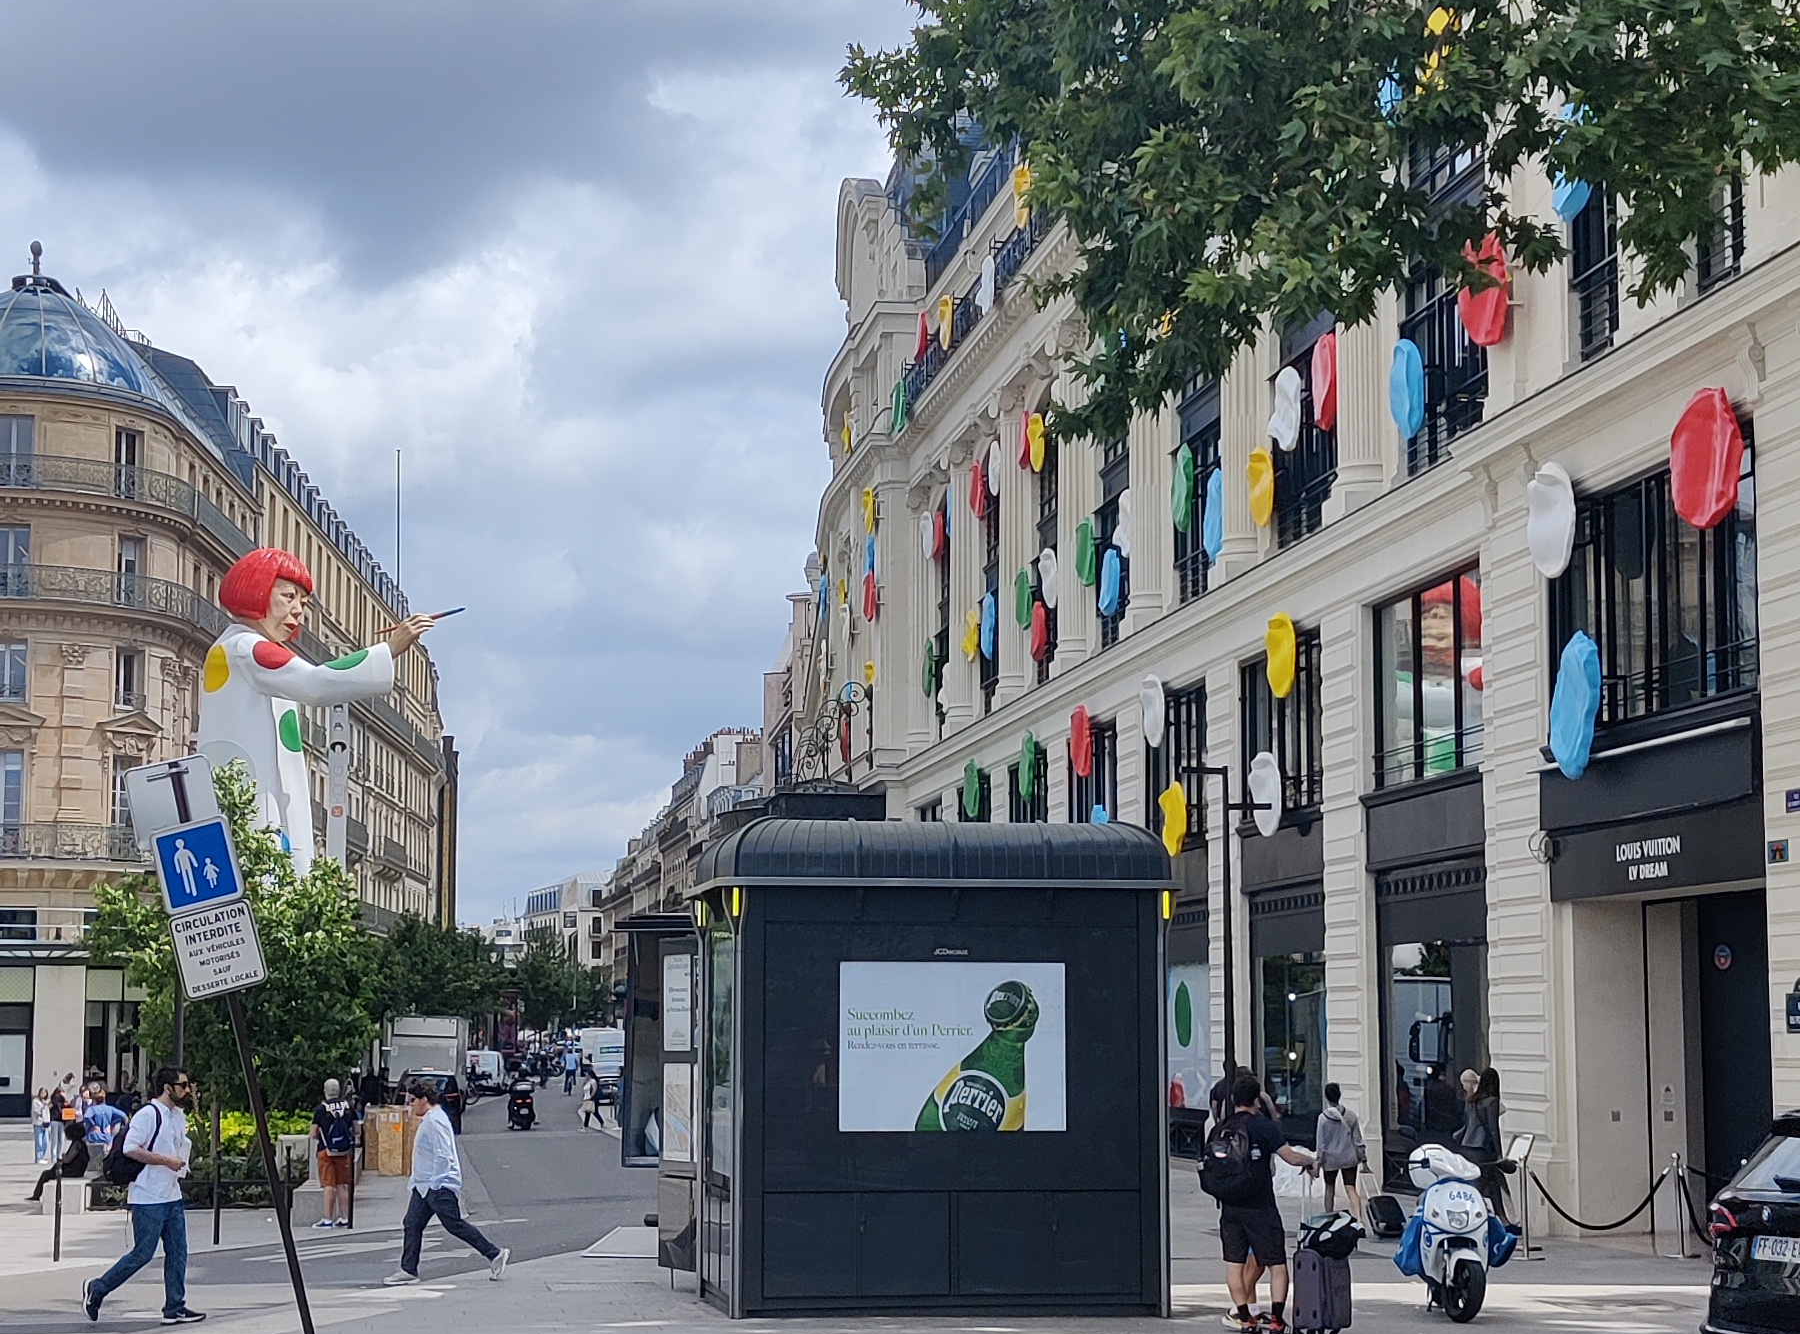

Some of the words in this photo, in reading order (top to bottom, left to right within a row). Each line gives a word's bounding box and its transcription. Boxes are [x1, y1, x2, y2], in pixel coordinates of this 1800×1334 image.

[1616, 841, 1642, 862] LOUIS
[1642, 835, 1680, 857] VUITTON
[1628, 865, 1638, 880] LV
[1639, 861, 1668, 879] DREAM
[174, 906, 246, 934] CIRCULATION
[184, 922, 242, 946] INTERDITE
[188, 949, 204, 958] AUX
[206, 937, 246, 954] VÉHICULES
[199, 951, 241, 966] MOTORISÉS
[212, 965, 232, 976] SAUF
[191, 978, 229, 993] DESSERTE
[230, 970, 259, 984] LOCALE
[847, 1008, 915, 1020] Succombez
[847, 1027, 861, 1036] au
[864, 1024, 900, 1040] plaisir
[902, 1024, 928, 1036] d'un
[931, 1024, 974, 1036] Perrier.
[847, 1040, 896, 1050] Rendez-vous
